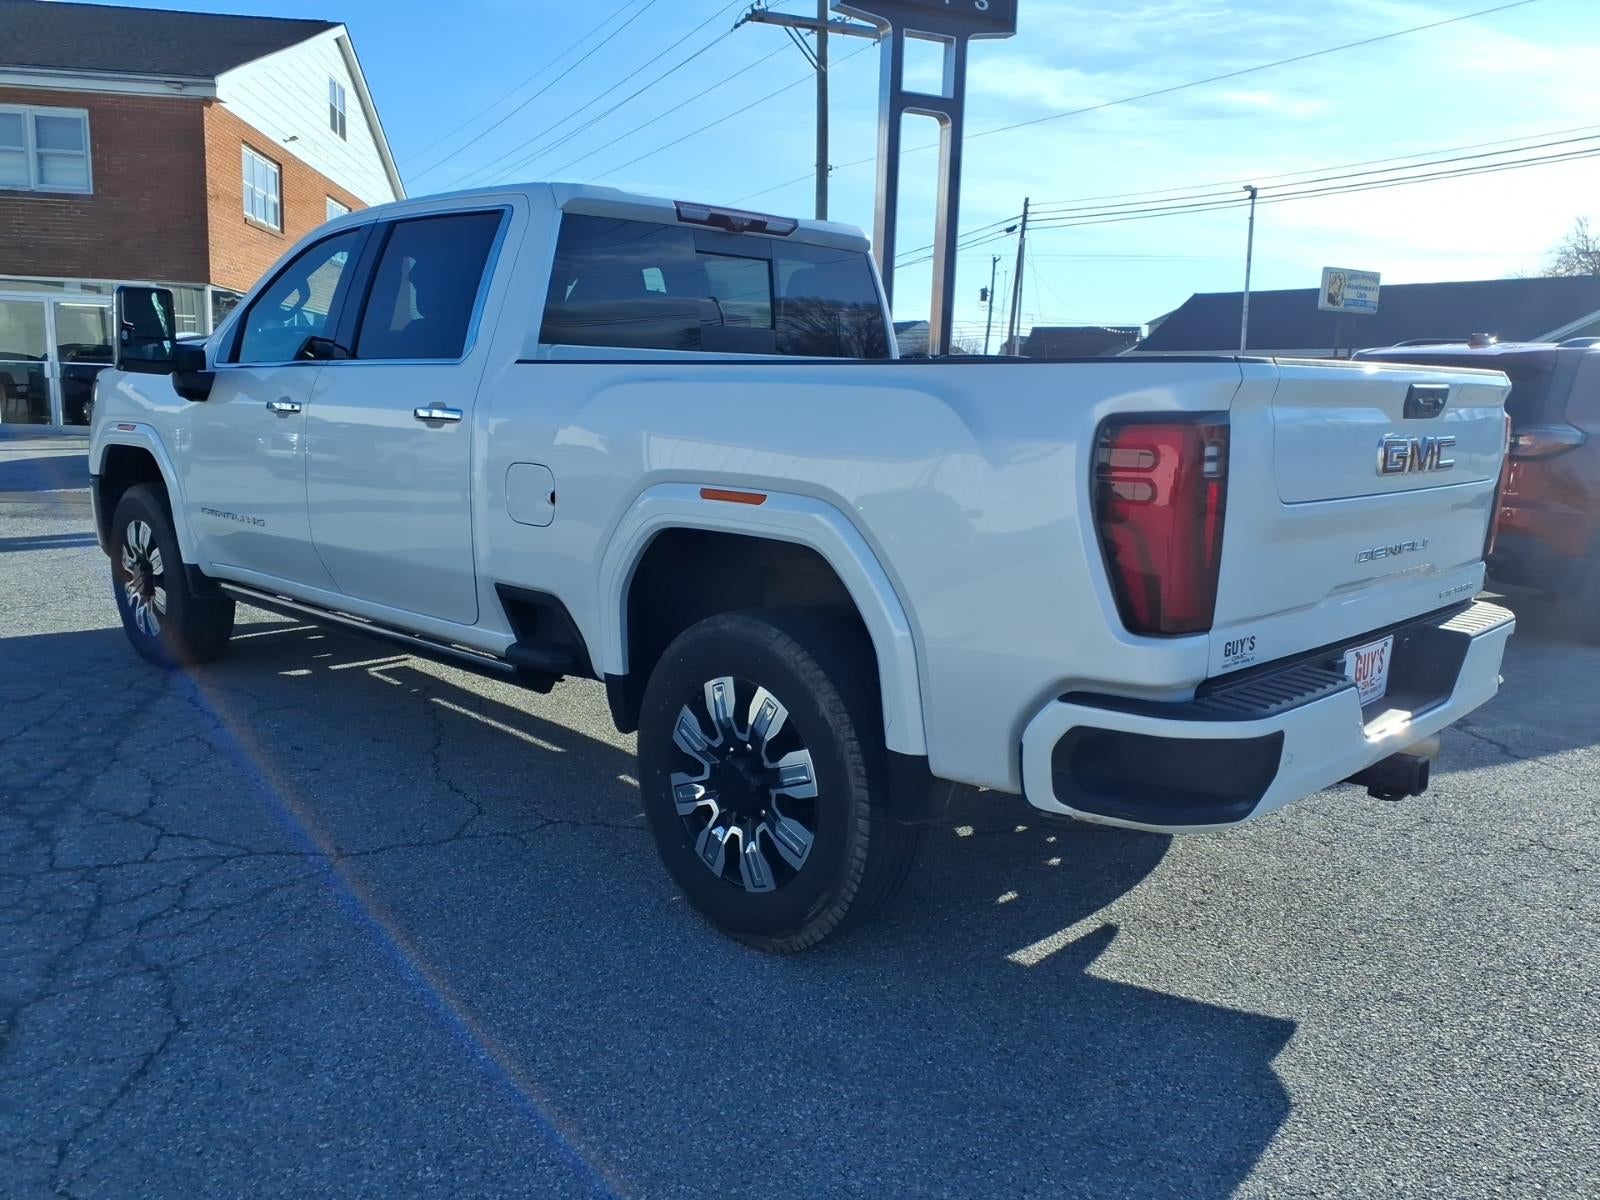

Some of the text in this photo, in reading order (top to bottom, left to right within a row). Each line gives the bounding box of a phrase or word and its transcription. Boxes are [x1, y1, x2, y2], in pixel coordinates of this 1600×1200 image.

[1376, 432, 1457, 476] GMC
[1354, 537, 1432, 564] DENALI
[1223, 635, 1256, 658] GUY'S
[1354, 647, 1385, 683] GUY'S
